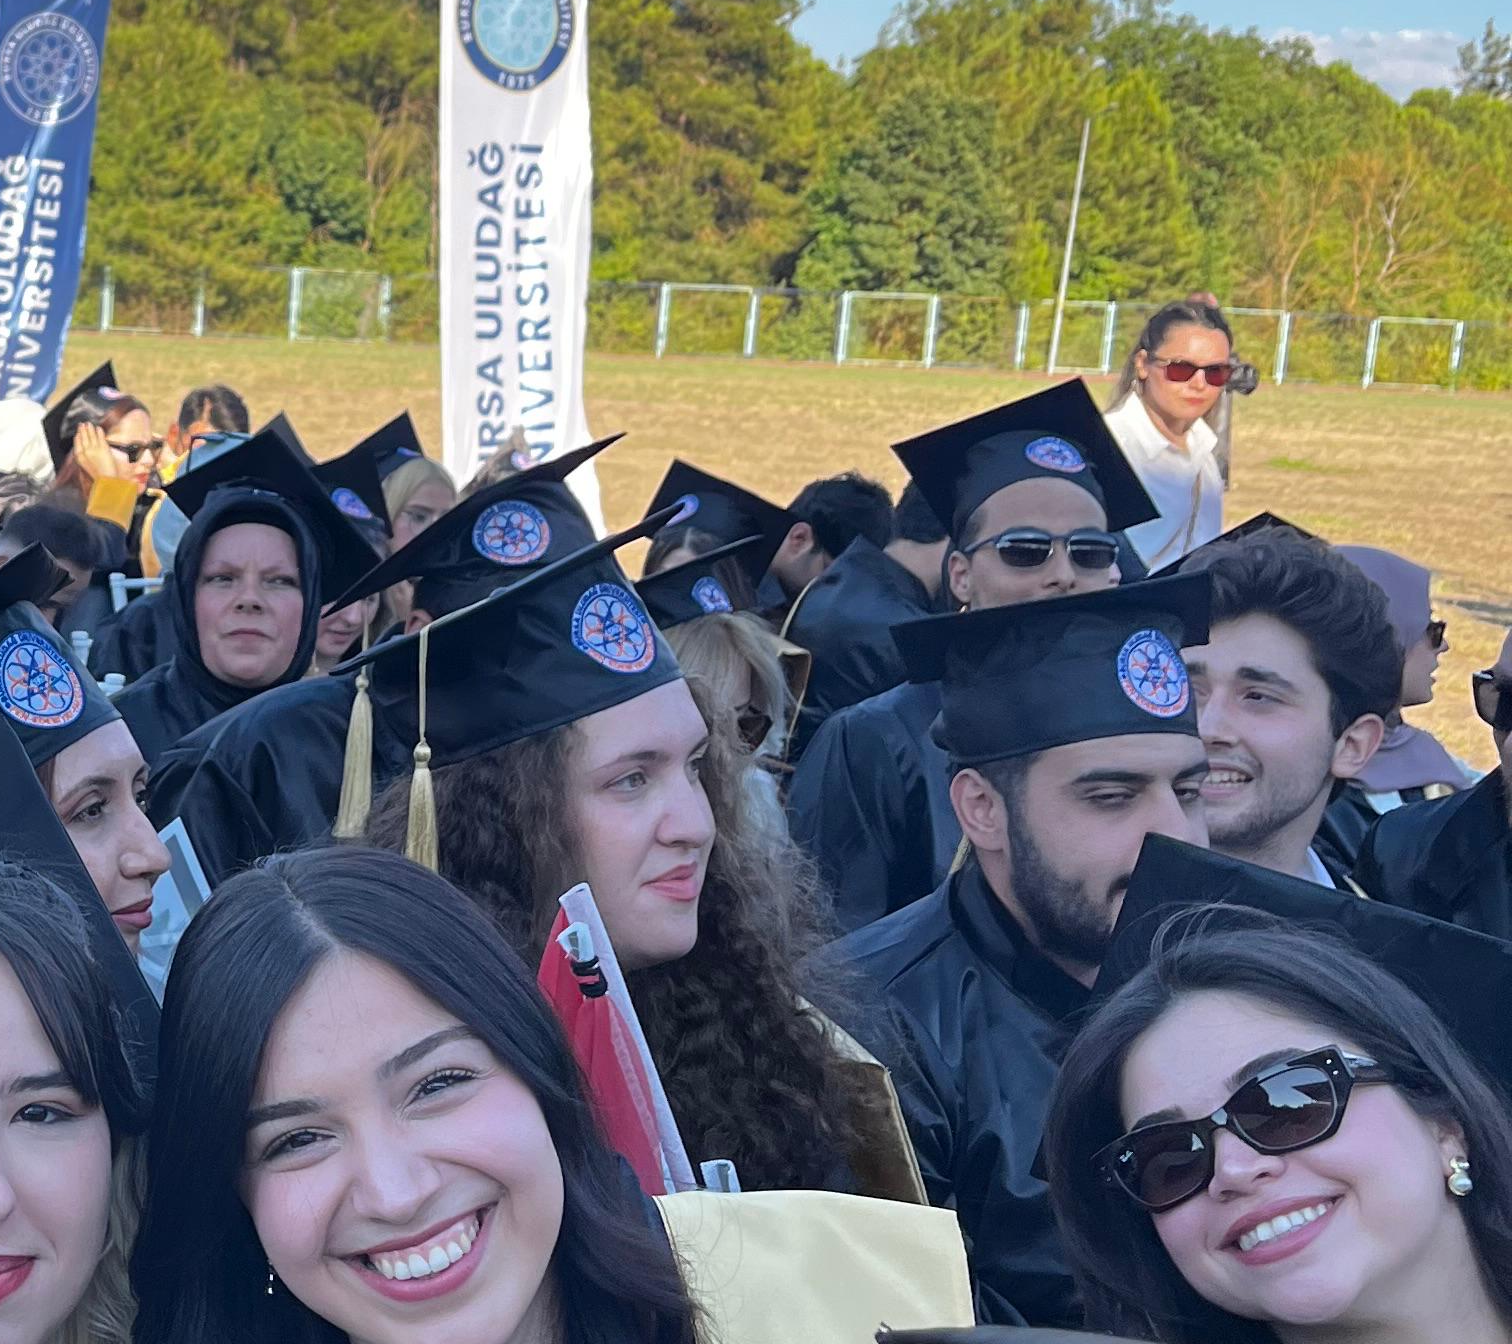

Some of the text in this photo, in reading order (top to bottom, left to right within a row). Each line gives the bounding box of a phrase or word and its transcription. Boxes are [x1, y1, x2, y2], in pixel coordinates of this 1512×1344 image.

[6, 158, 66, 399] NİVERSİTESİ
[466, 141, 506, 460] RSA ULUDAĞ
